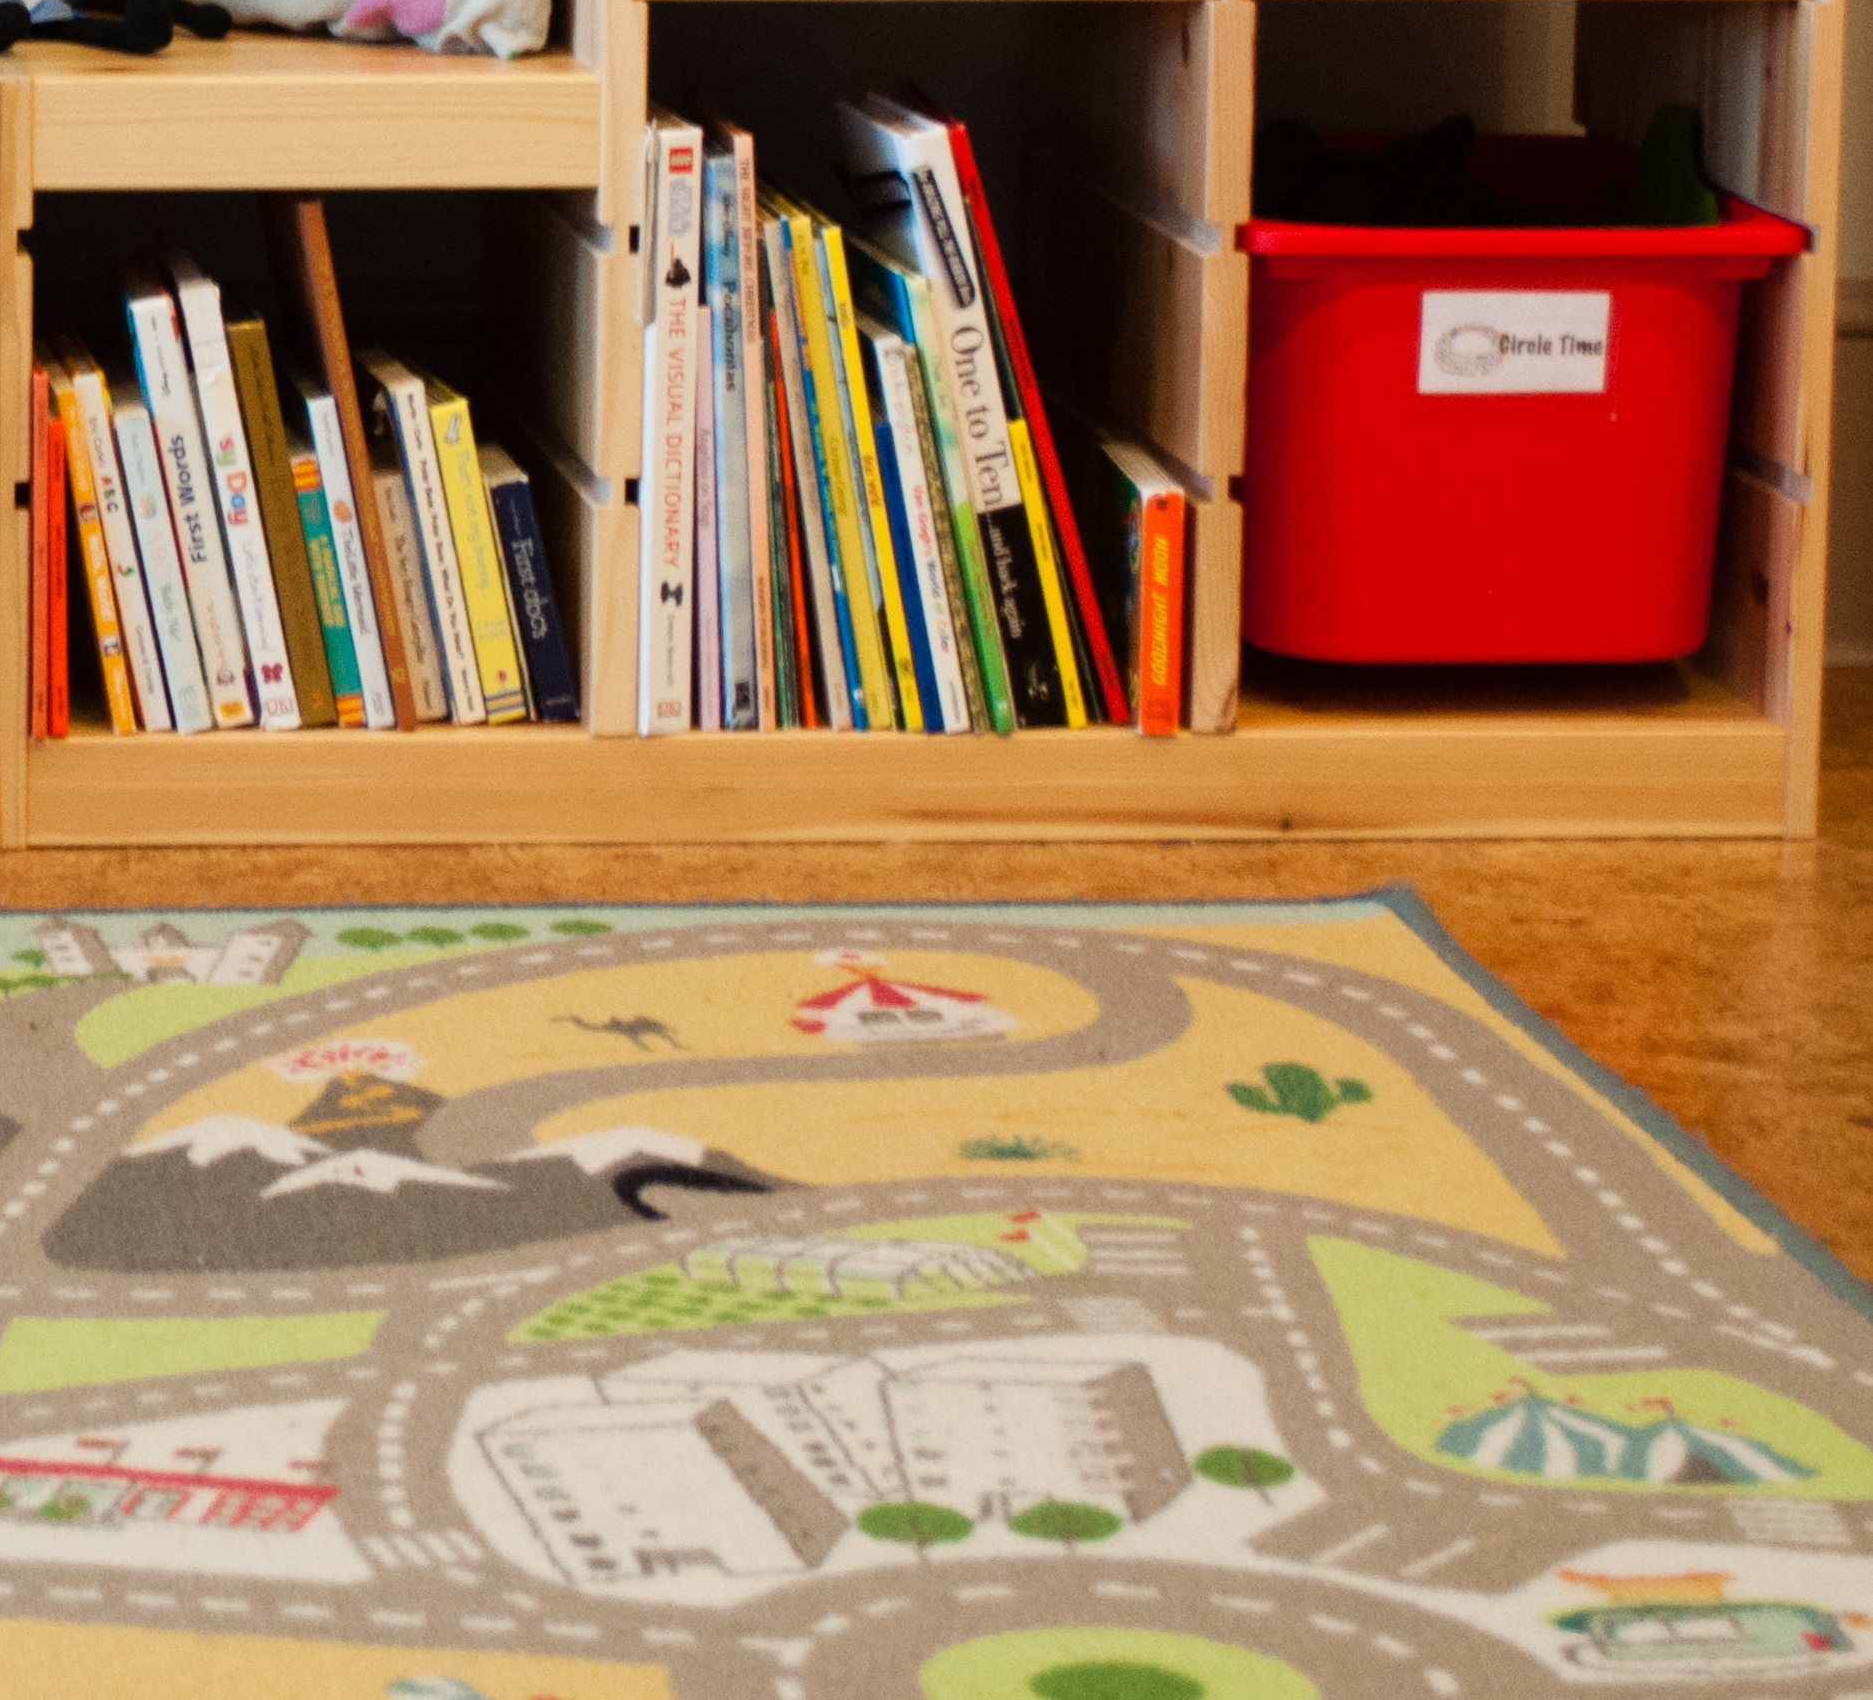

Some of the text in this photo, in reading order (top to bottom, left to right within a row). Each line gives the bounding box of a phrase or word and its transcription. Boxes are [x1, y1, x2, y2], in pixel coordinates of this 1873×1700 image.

[719, 279, 740, 392] Pocahontas
[1500, 334, 1603, 357] Circle Time
[660, 299, 685, 568] THE VISUAL DICTIONARY
[948, 324, 1016, 511] One to Ten
[167, 432, 209, 564] First Words
[218, 470, 256, 528] Day
[922, 558, 943, 600] World
[1150, 536, 1169, 685] GOODNIGHT MOON
